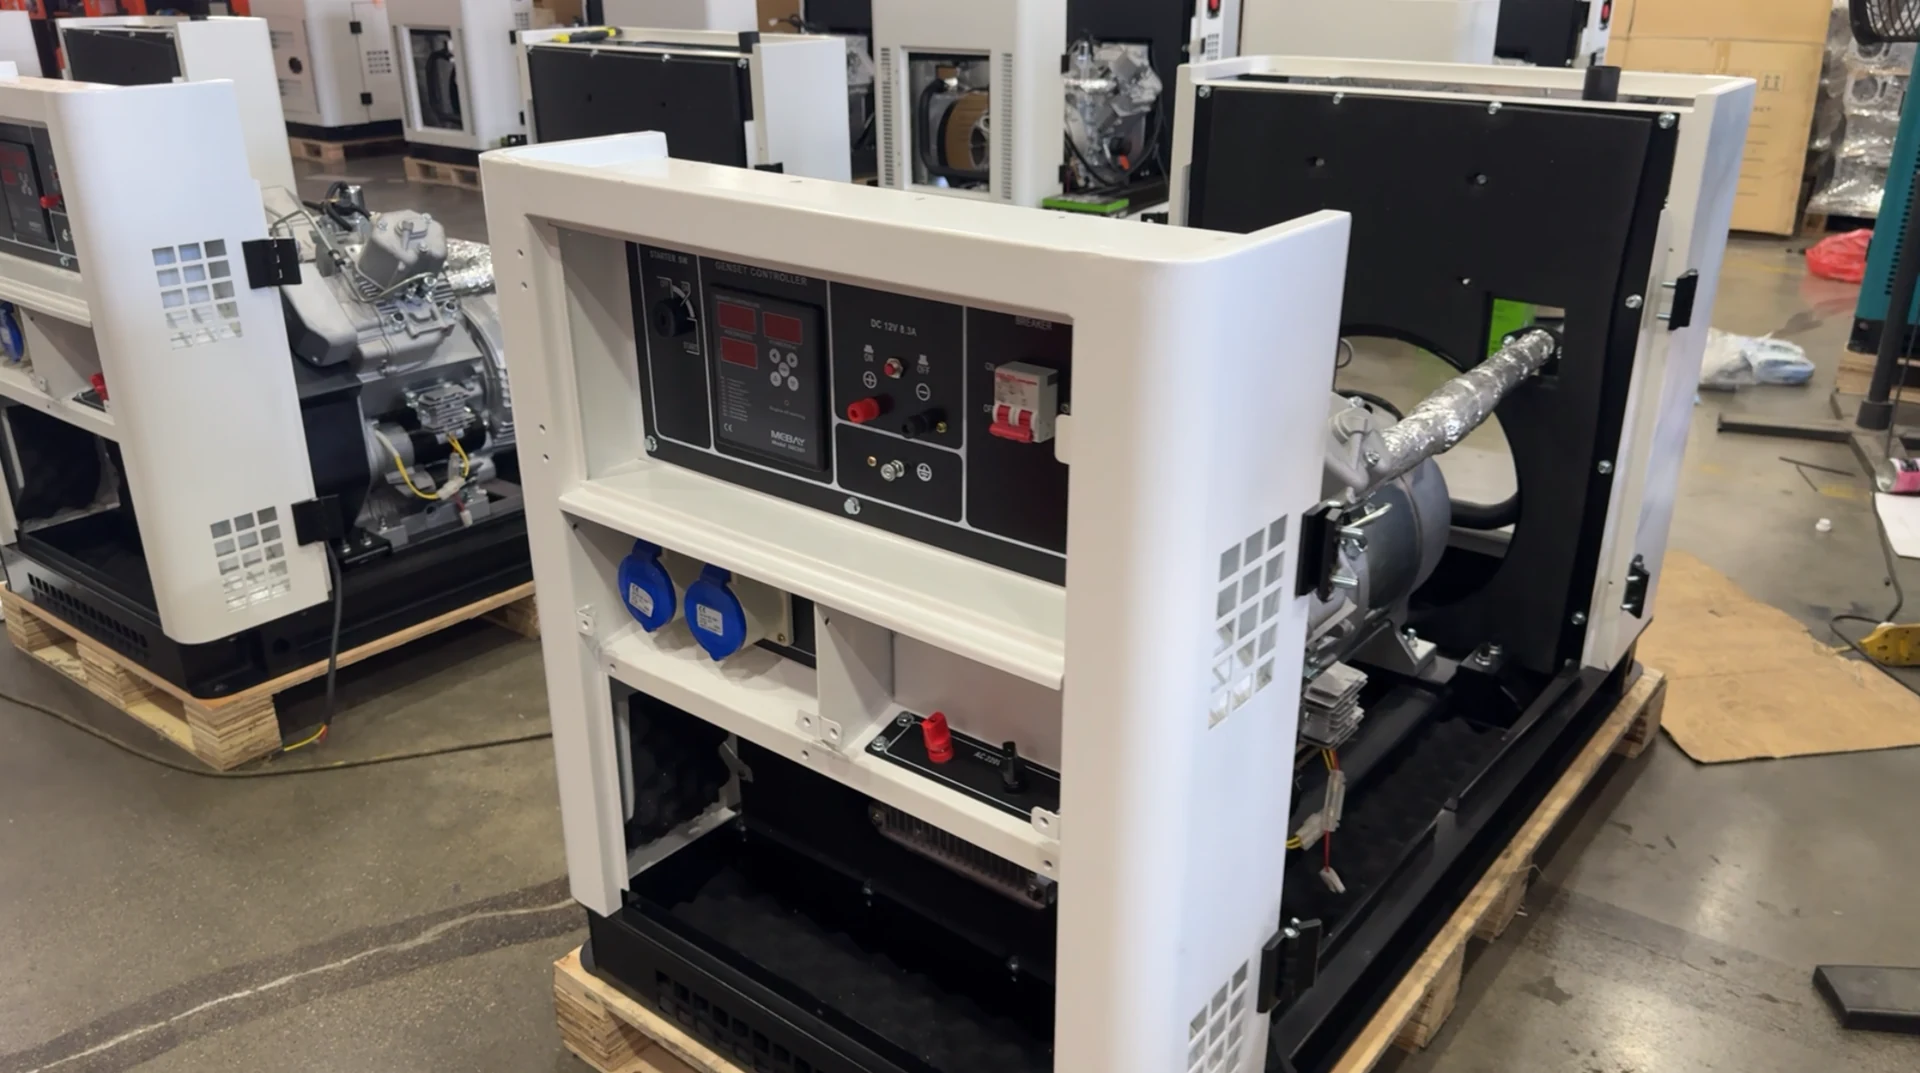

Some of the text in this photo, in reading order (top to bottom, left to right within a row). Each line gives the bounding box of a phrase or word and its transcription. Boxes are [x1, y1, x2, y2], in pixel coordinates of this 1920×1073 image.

[650, 250, 676, 263] STARTER
[715, 261, 808, 287] GENSET CONTROLLER
[870, 318, 917, 337] DC 12V 8.3A
[1015, 316, 1053, 331] BREAKER
[864, 352, 874, 363] ON
[916, 364, 931, 376] OFF
[723, 422, 734, 433] CE
[770, 429, 806, 447] MEBAY
[973, 751, 986, 760] AC
